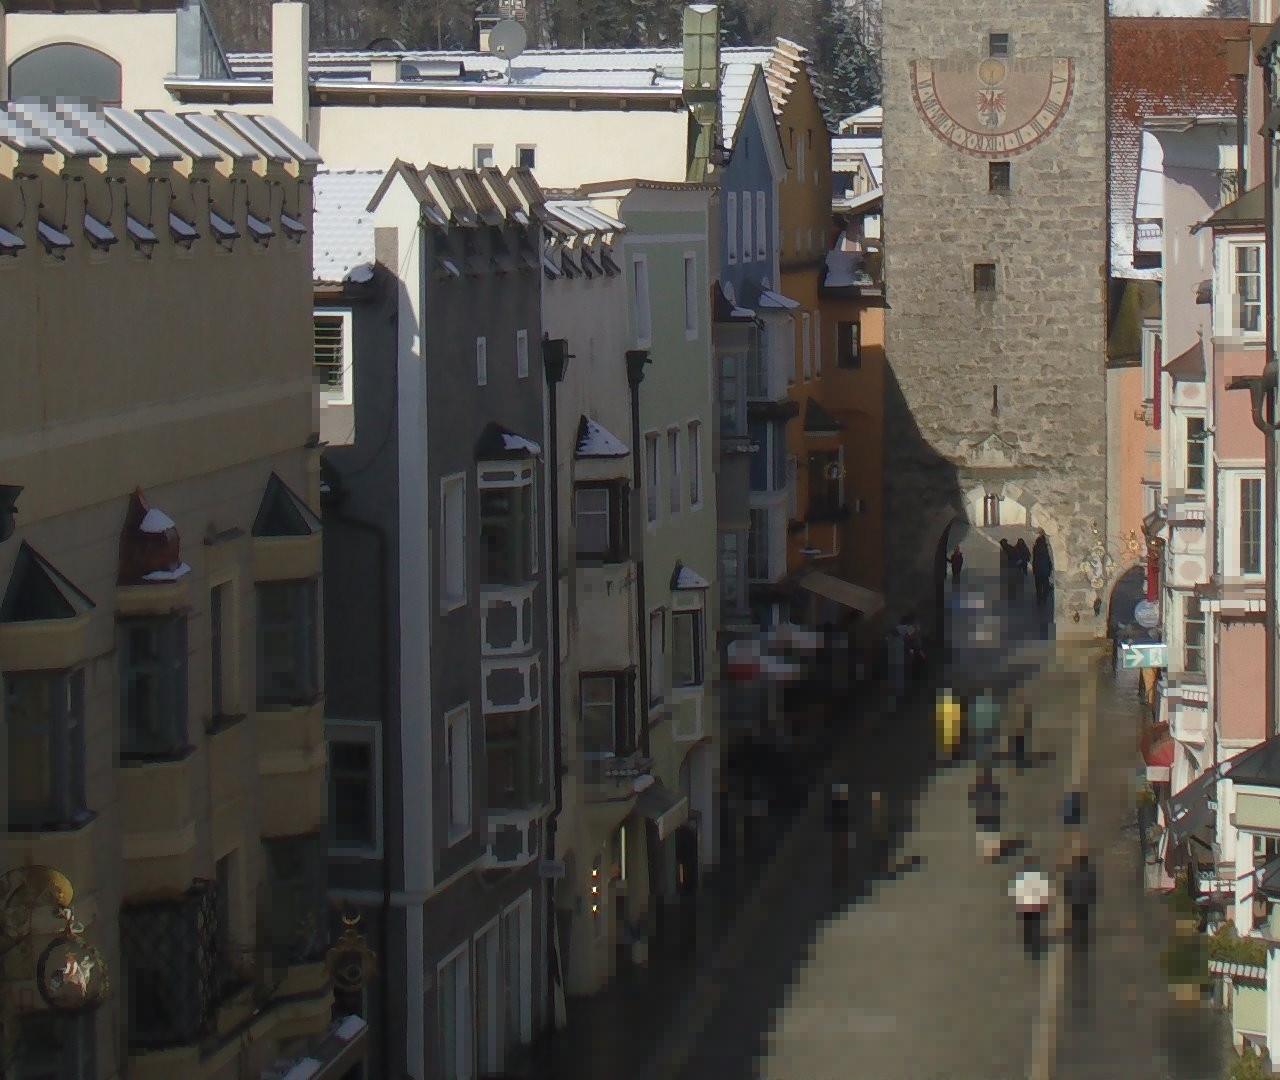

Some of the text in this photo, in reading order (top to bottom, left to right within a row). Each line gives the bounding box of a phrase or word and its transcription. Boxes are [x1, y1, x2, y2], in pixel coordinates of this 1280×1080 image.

[1052, 75, 1067, 85] V
[1044, 100, 1061, 116] IIII
[1030, 119, 1045, 136] III
[1014, 129, 1025, 146] II
